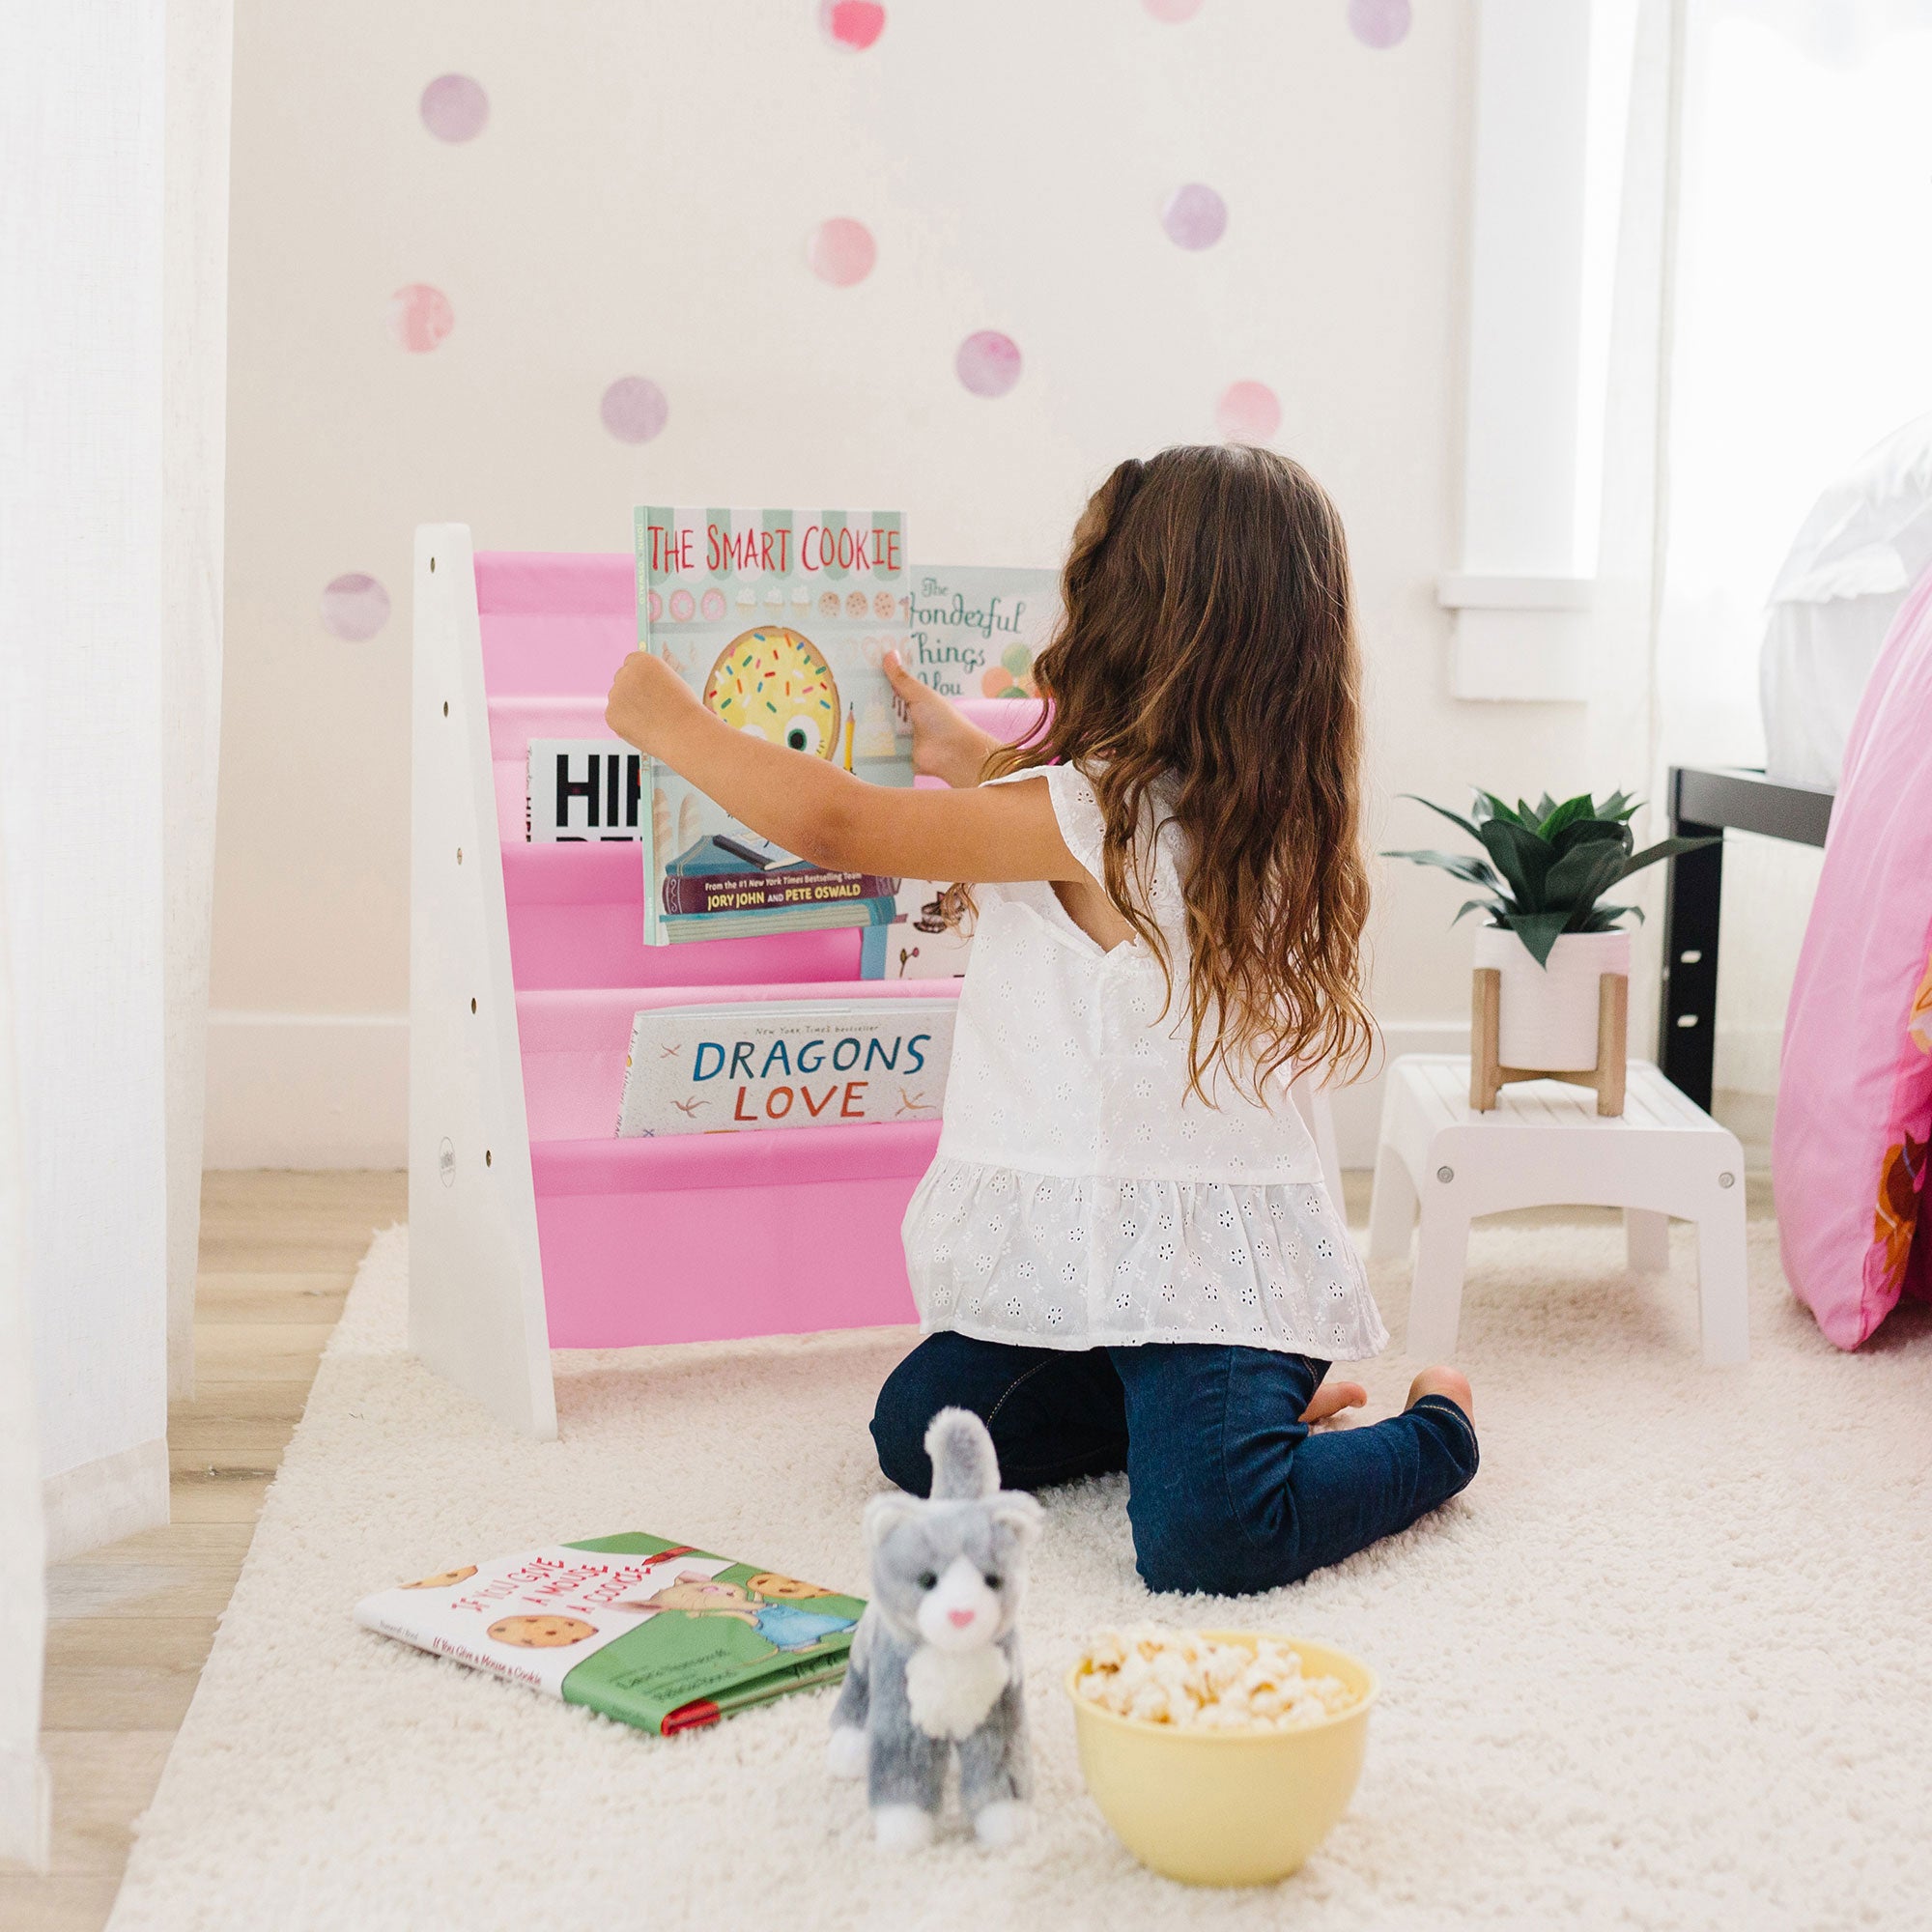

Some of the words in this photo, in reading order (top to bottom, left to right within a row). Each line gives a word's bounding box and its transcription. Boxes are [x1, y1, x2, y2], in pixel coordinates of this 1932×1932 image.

[647, 526, 695, 573] THE
[706, 524, 791, 572] SMART
[802, 525, 901, 572] COOKIE
[922, 577, 949, 598] The
[705, 882, 724, 892] From
[724, 880, 737, 890] the
[739, 879, 748, 889] #1
[749, 878, 764, 888] New
[766, 877, 781, 887] York
[783, 875, 804, 885] Times
[805, 872, 842, 884] Bestselling
[843, 871, 862, 881] Team
[707, 895, 734, 911] JORY
[736, 892, 765, 909] JOHN
[767, 893, 784, 903] AND
[785, 887, 811, 901] PETE
[814, 883, 862, 899] OSWALD
[693, 1034, 932, 1082] DRAGONS
[733, 1081, 868, 1122] LOVE
[507, 1556, 564, 1583] GIVE
[534, 1564, 609, 1598] MOUSE
[522, 1596, 552, 1606] A
[566, 1604, 596, 1614] A
